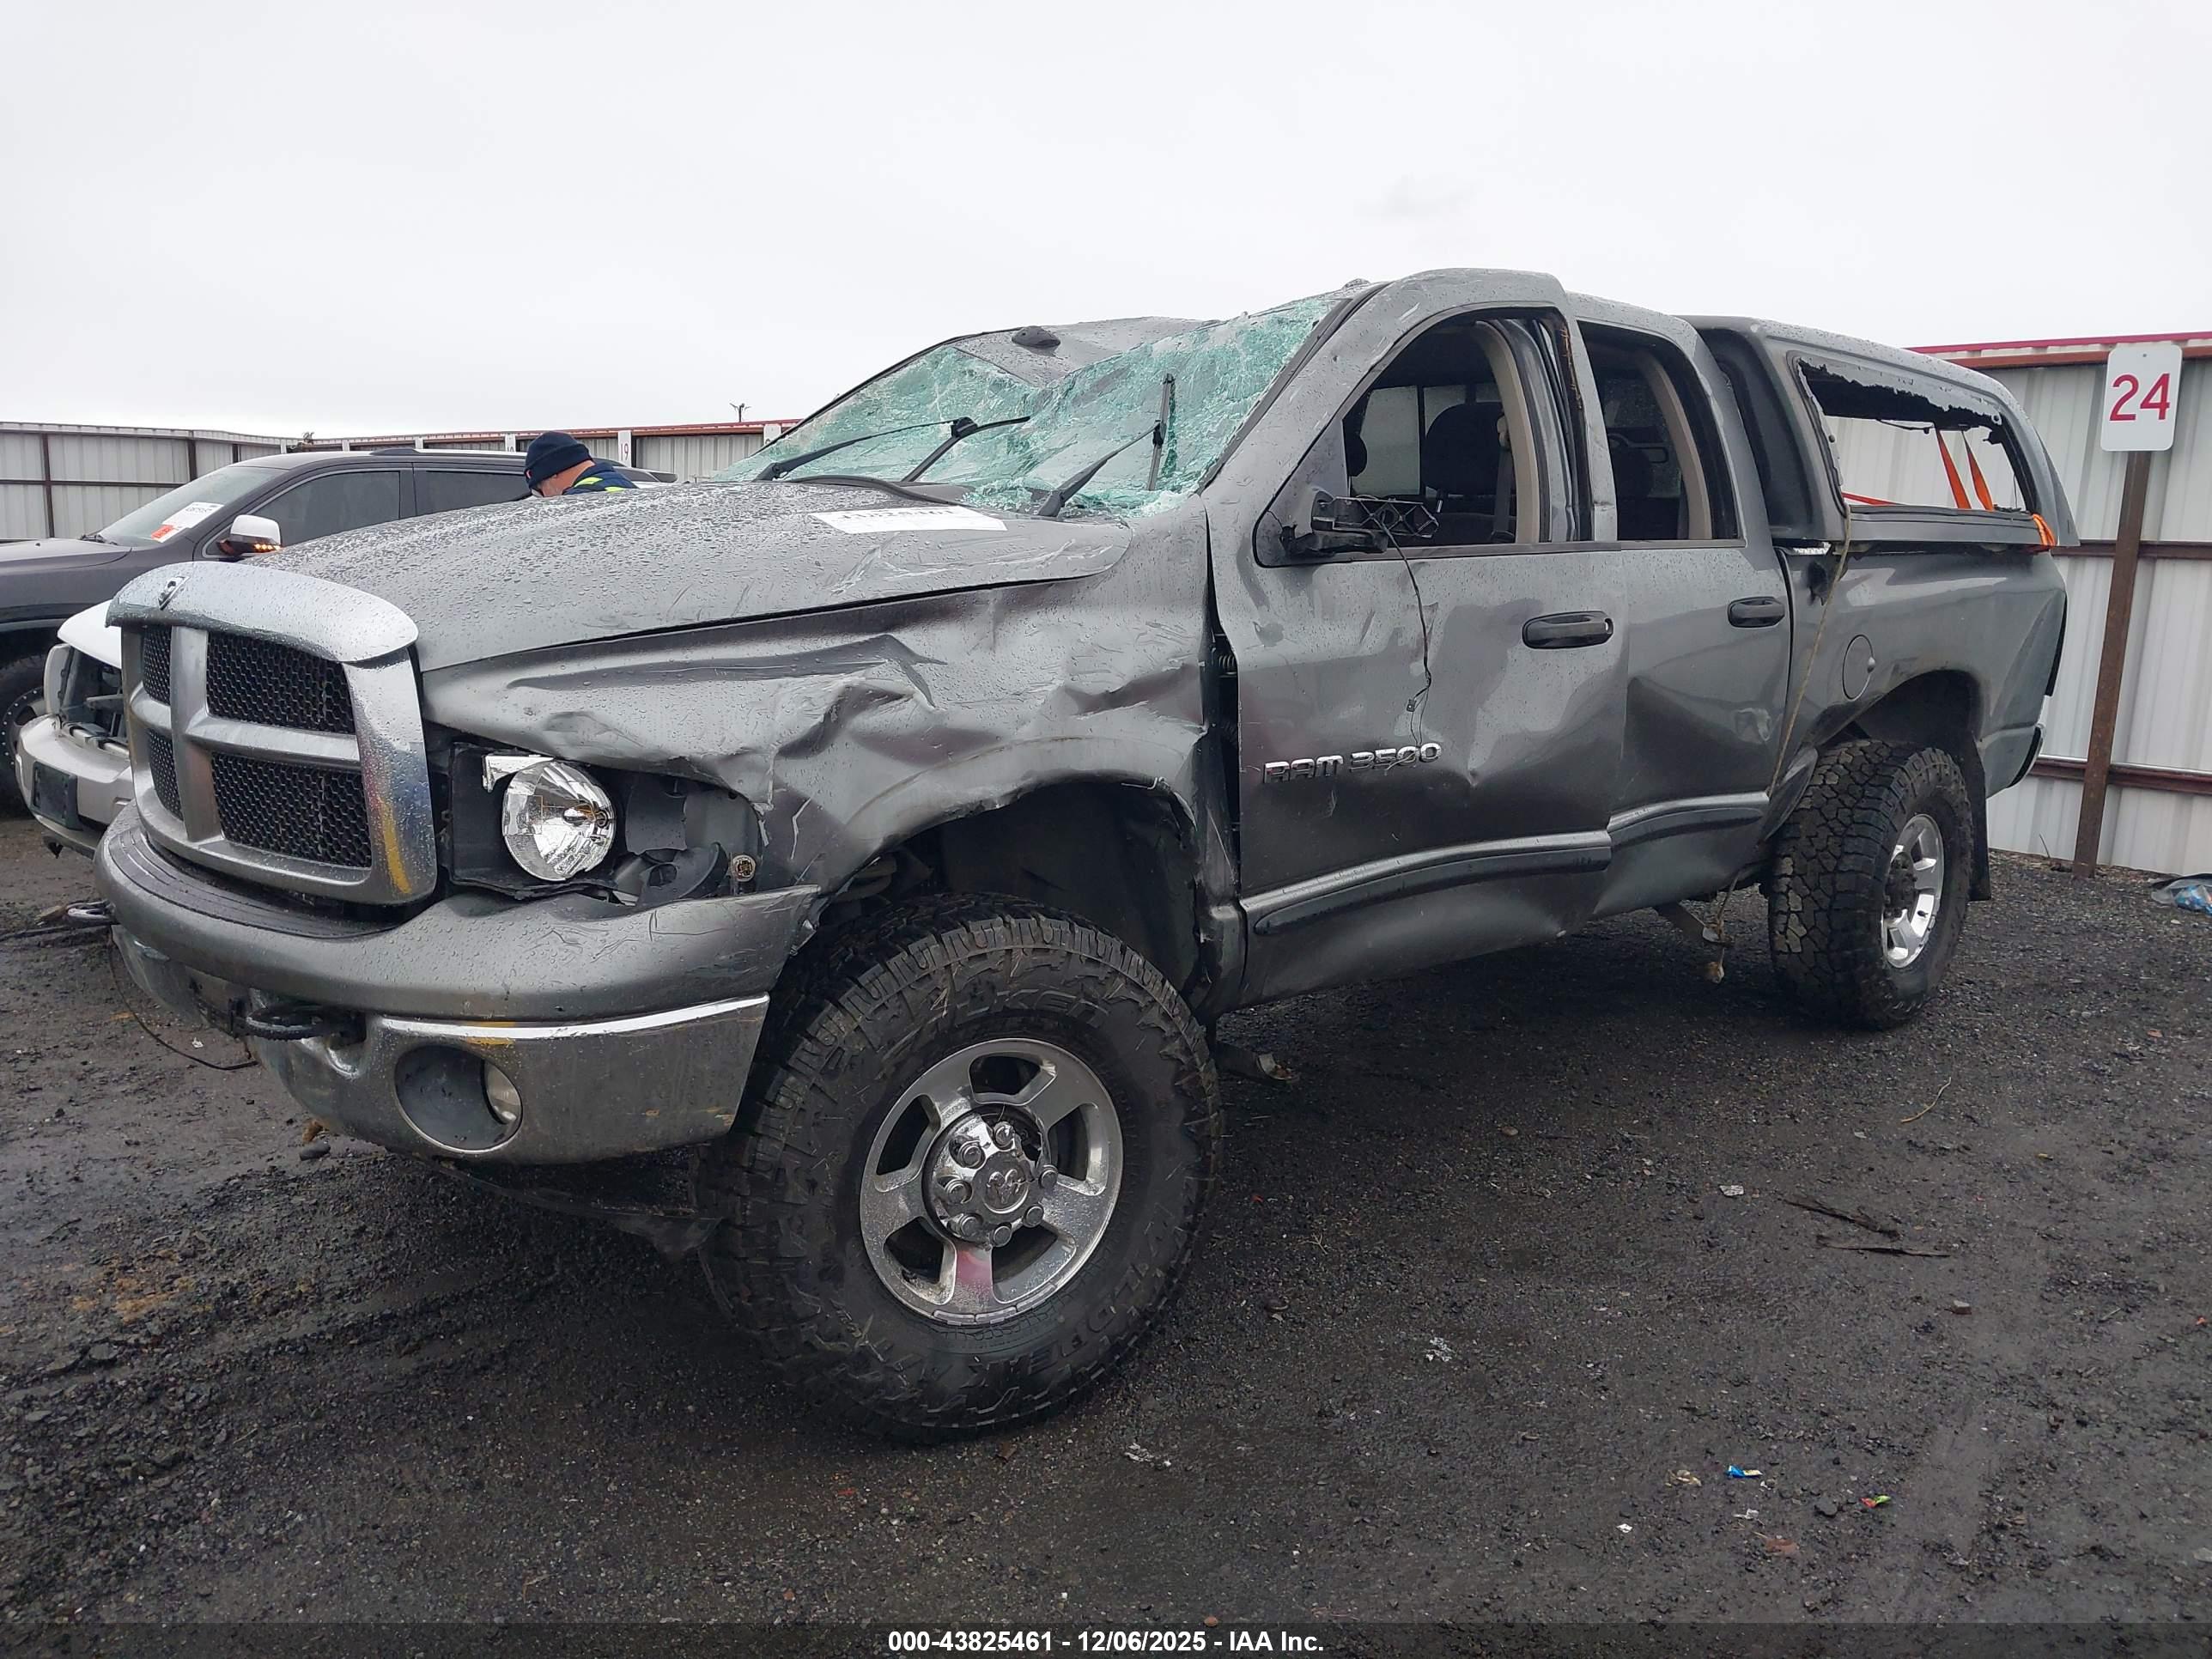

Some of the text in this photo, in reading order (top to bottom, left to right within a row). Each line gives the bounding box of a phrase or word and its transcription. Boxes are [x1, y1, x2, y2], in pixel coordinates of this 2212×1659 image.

[2109, 373, 2171, 421] 24
[620, 443, 629, 458] 19
[1263, 754, 1344, 783] RAM
